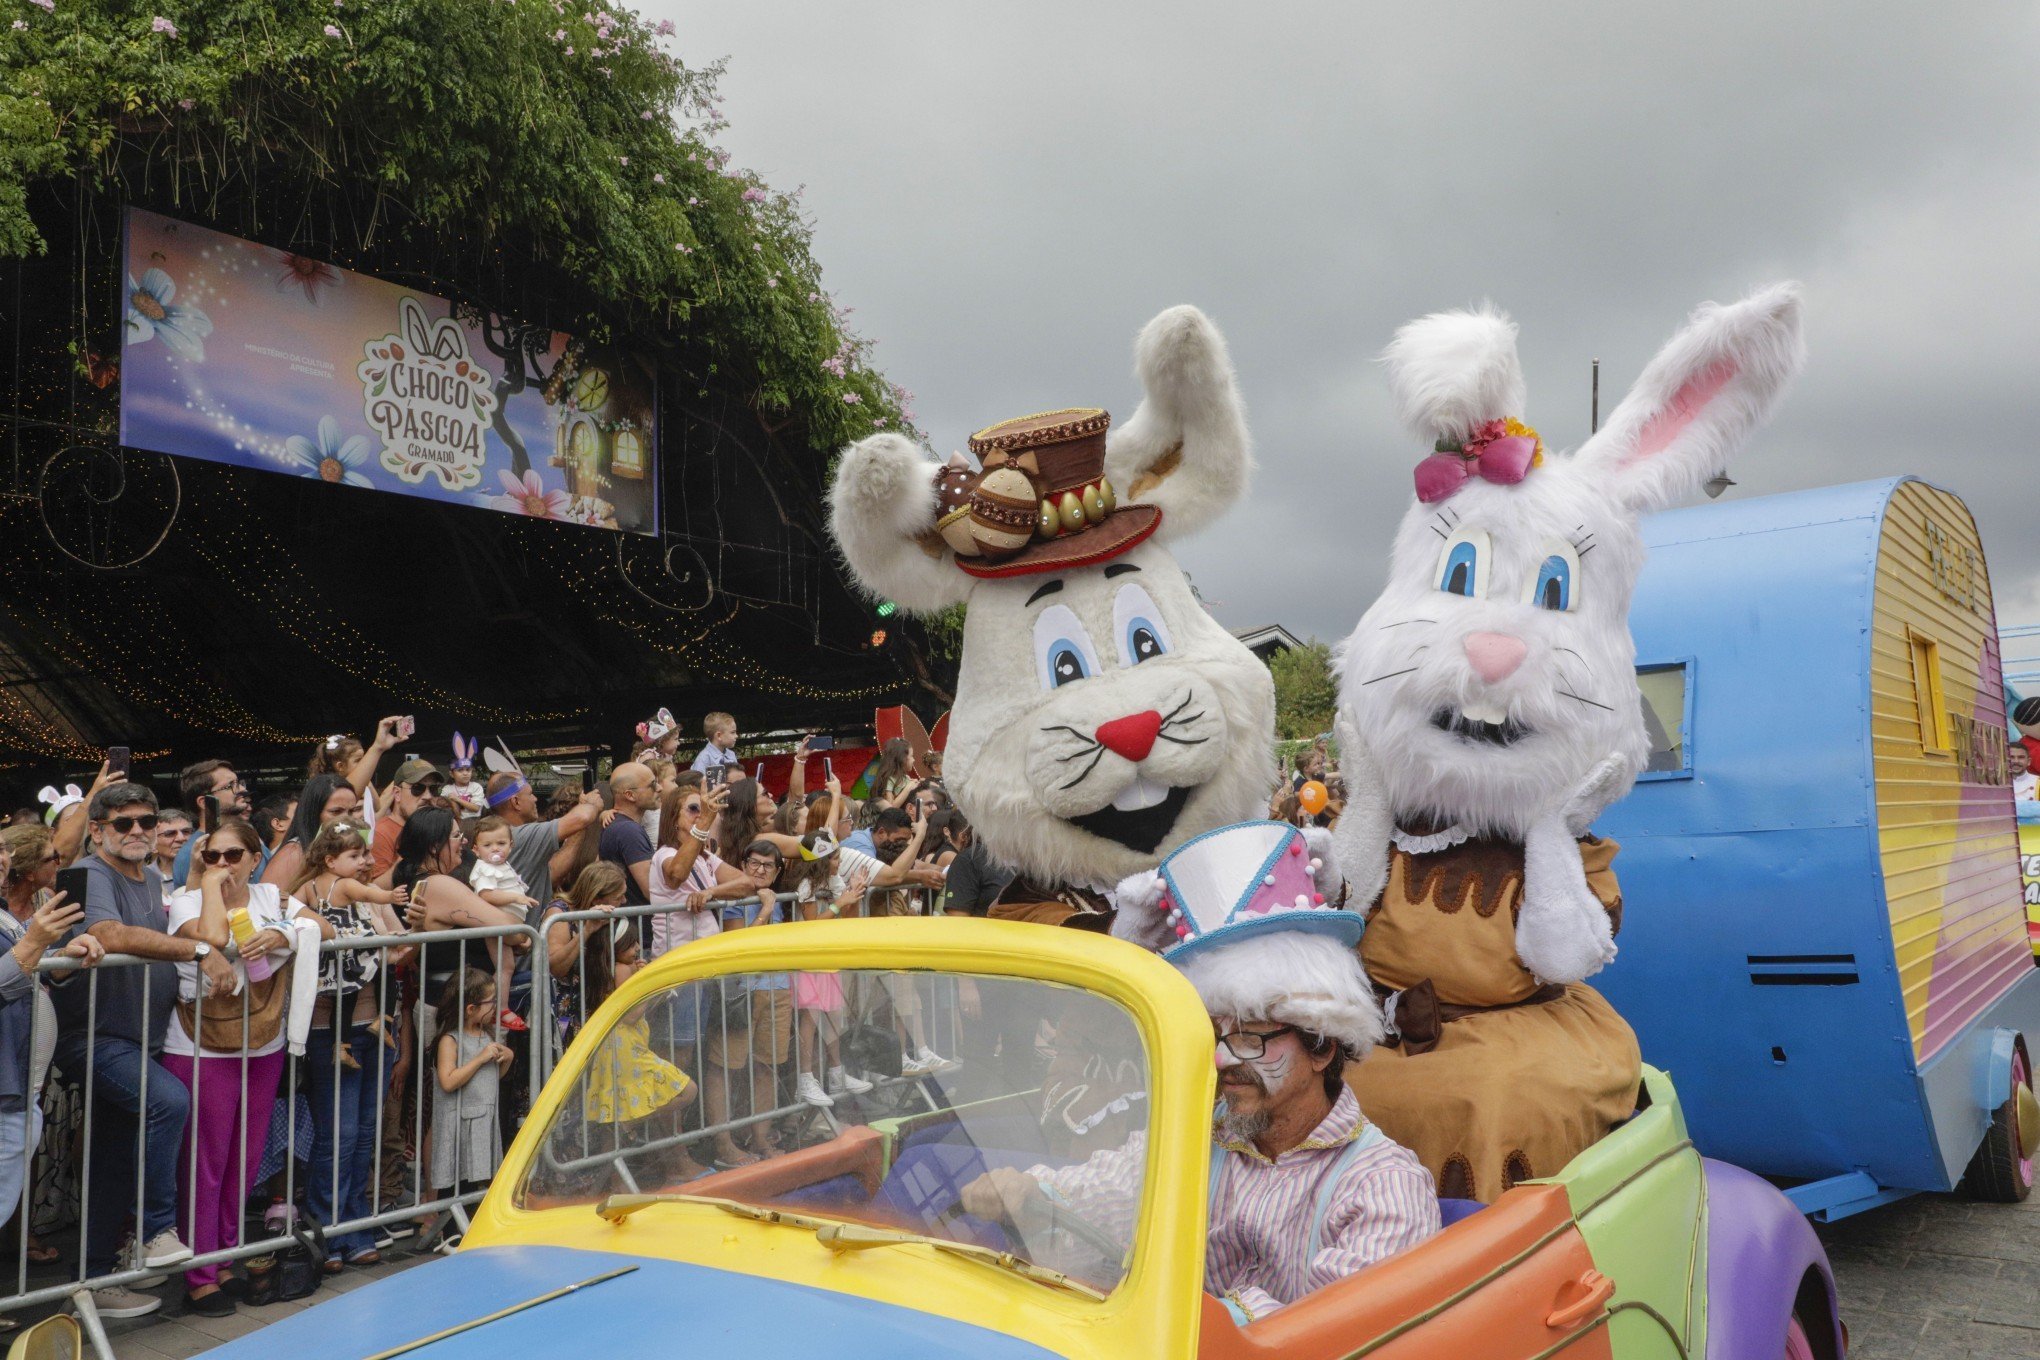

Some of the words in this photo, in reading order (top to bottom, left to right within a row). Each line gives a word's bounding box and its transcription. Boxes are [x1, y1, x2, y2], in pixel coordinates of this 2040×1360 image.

[244, 342, 289, 360] MINISTÉRIO
[289, 353, 301, 362] DA
[301, 356, 335, 371] CULTURA
[390, 362, 469, 409] CHOCO
[372, 399, 480, 458] PÁSCOA
[407, 443, 455, 463] GRAMADO
